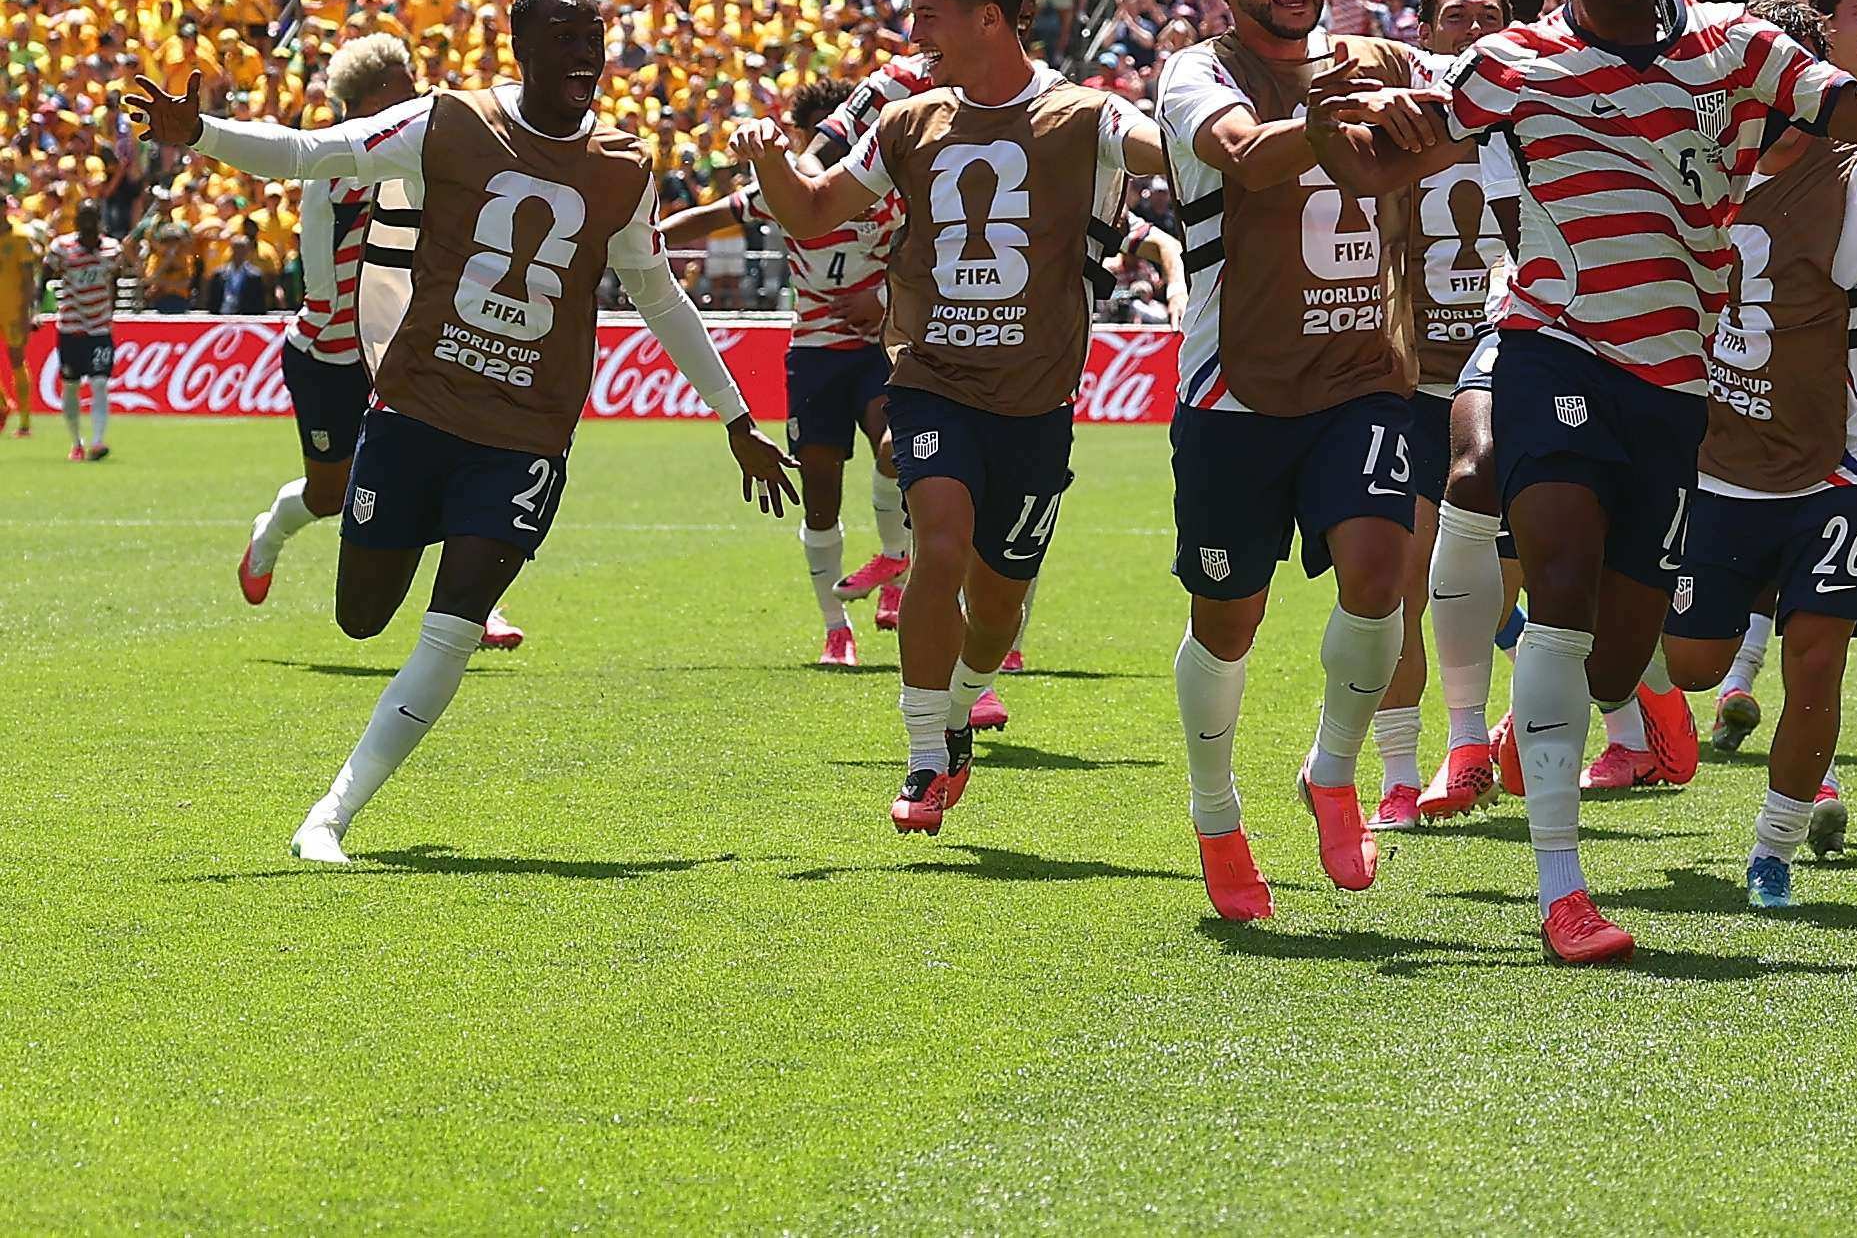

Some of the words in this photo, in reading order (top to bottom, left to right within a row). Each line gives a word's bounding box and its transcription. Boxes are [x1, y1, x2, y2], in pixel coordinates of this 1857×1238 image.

[1696, 92, 1725, 114] USA
[1335, 241, 1375, 262] FIFA
[826, 251, 846, 286] 4
[955, 267, 1001, 285] FIFA
[1303, 286, 1370, 305] WORLD
[481, 299, 526, 326] FIFA
[931, 304, 989, 321] WORLD
[992, 306, 1027, 321] CUP
[1424, 308, 1483, 319] WORLD
[441, 322, 504, 354] WORLD
[507, 345, 541, 364] CUP
[924, 321, 1025, 347] 2026
[1722, 330, 1747, 355] FIFA
[434, 338, 534, 387] 2026
[1710, 364, 1741, 386] ORLD
[1741, 376, 1772, 395] CUP
[1708, 380, 1772, 420] 026
[1362, 424, 1411, 483] 15
[1005, 492, 1060, 547] 14
